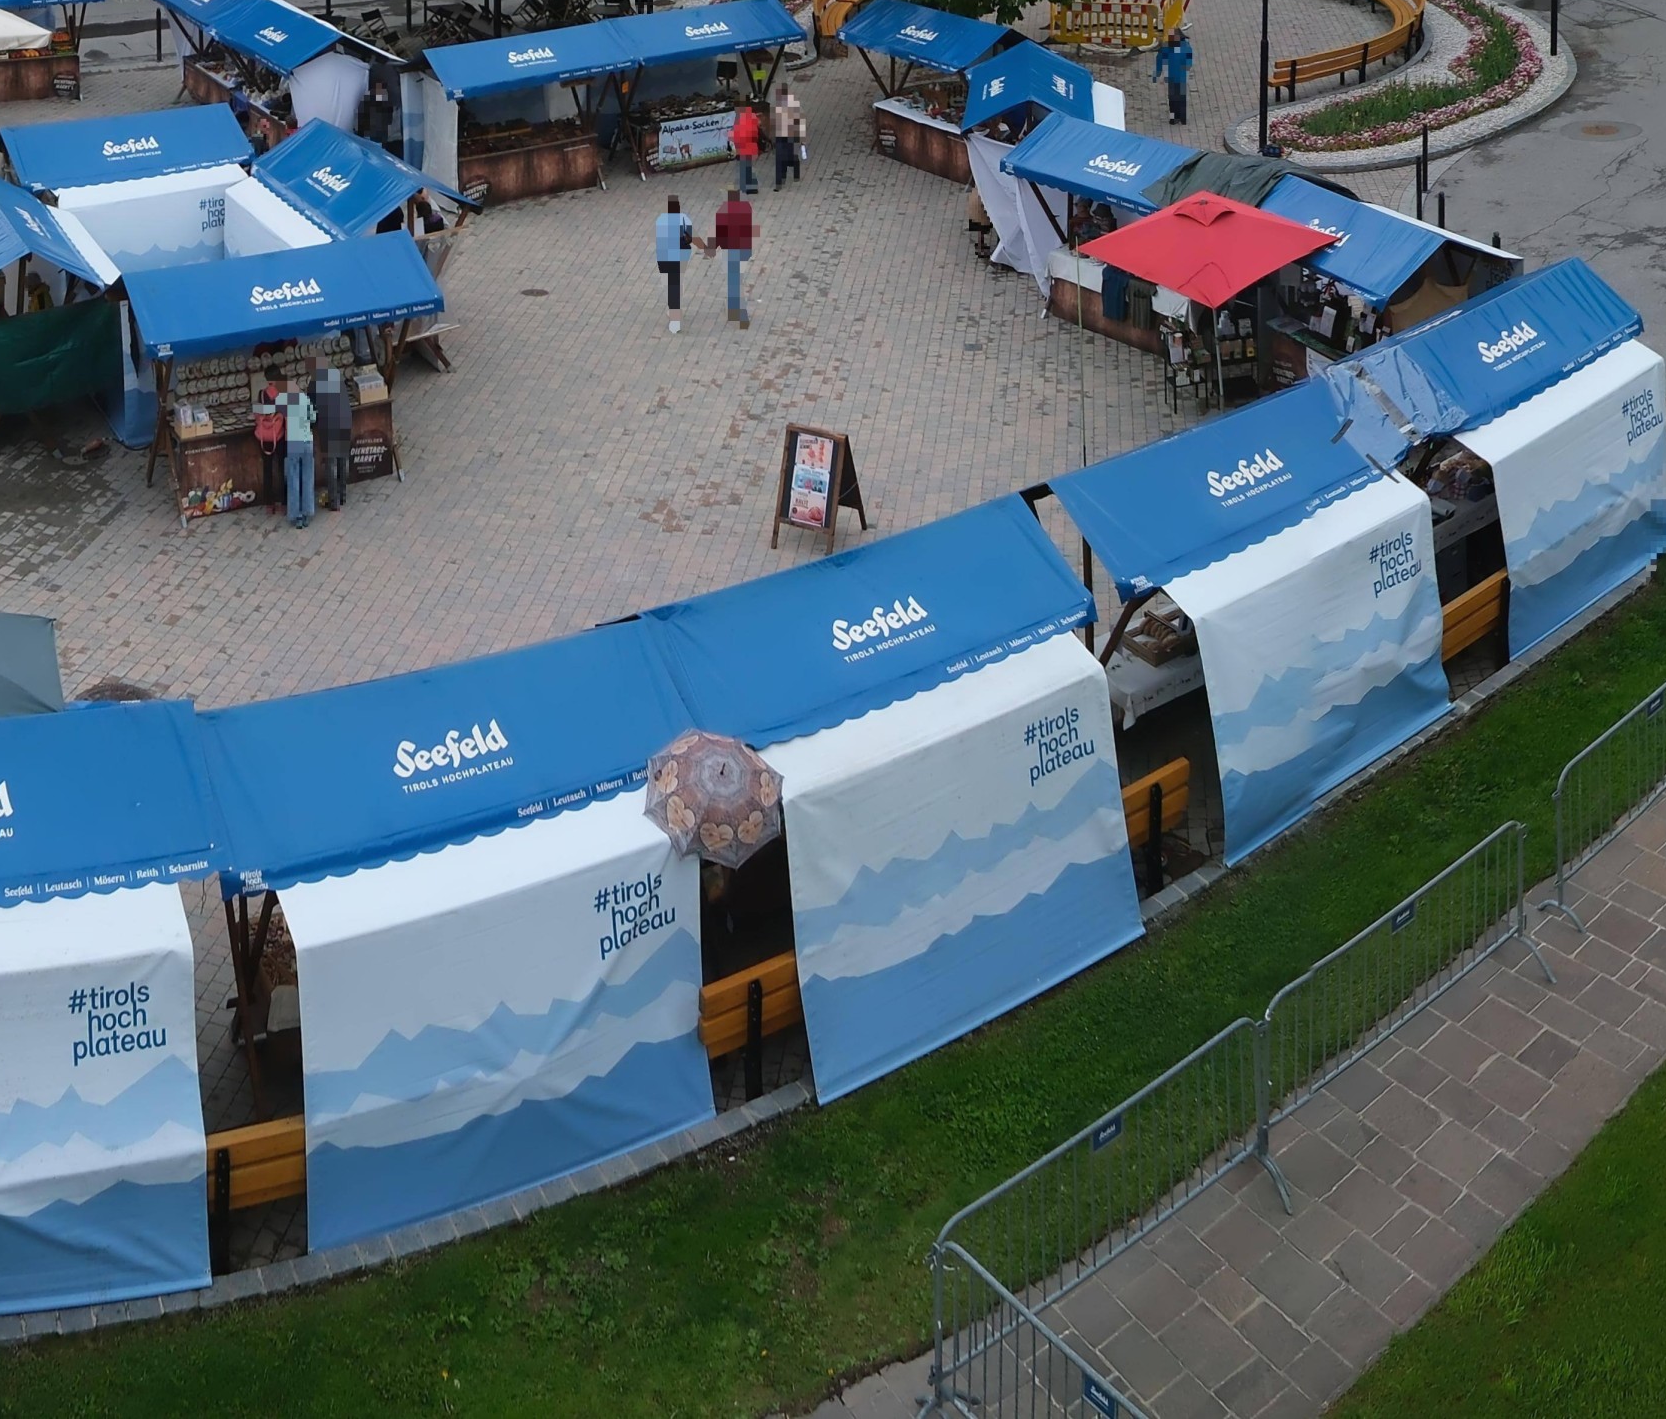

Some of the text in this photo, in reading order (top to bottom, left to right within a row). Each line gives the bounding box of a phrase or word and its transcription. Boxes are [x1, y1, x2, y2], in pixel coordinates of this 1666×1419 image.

[260, 26, 288, 43] Seefeld
[685, 21, 730, 39] Seefeld
[901, 25, 937, 42] Seefeld
[507, 47, 554, 64] Seefeld
[661, 120, 719, 135] Alpaka-Socken
[102, 136, 159, 157] Seefeld
[312, 167, 350, 193] Seefeld
[1088, 154, 1139, 177] Seefeld
[250, 278, 322, 306] Seefeld
[255, 296, 324, 312] TIROLS HOCHPLATEAU
[1477, 321, 1538, 364] Seefeld
[1622, 388, 1654, 416] #tirols
[1630, 402, 1655, 428] hoch
[1626, 410, 1664, 446] plateau
[351, 446, 388, 455] DIENSTAGS-
[353, 454, 382, 464] MARKT'L
[1205, 447, 1285, 499] Seefeld
[1221, 473, 1293, 509] TIROLS HOCHPLATEAU
[1369, 531, 1414, 565] #tirols
[1379, 549, 1416, 579] hoch
[1373, 558, 1423, 599] plateau
[832, 595, 928, 651] Seefeld
[844, 624, 937, 663] TIROLS HOCHPLATEAU
[946, 610, 1089, 675] Seefeld Leutasch Mösern Reith Scharnitz
[1024, 706, 1080, 745] #tirols
[1037, 725, 1079, 757] hoch
[393, 718, 509, 779] Seefeld
[1029, 741, 1096, 786] plateau
[402, 756, 514, 795] TIROLS HOCHPLATEAU
[517, 801, 544, 818] Seefeld
[552, 788, 587, 807] Leutasch
[596, 777, 624, 795] Mösern
[3, 859, 209, 898] Seefeld Leutasch Mösern Reith Scharnitz
[239, 869, 262, 881] #tirols
[242, 882, 269, 893] plateau
[594, 872, 664, 914] #tirols
[611, 893, 661, 927] hoch
[600, 905, 677, 960] plateau
[67, 981, 151, 1015] #tirols
[87, 1005, 148, 1039] hoch
[72, 1025, 167, 1067] plateau
